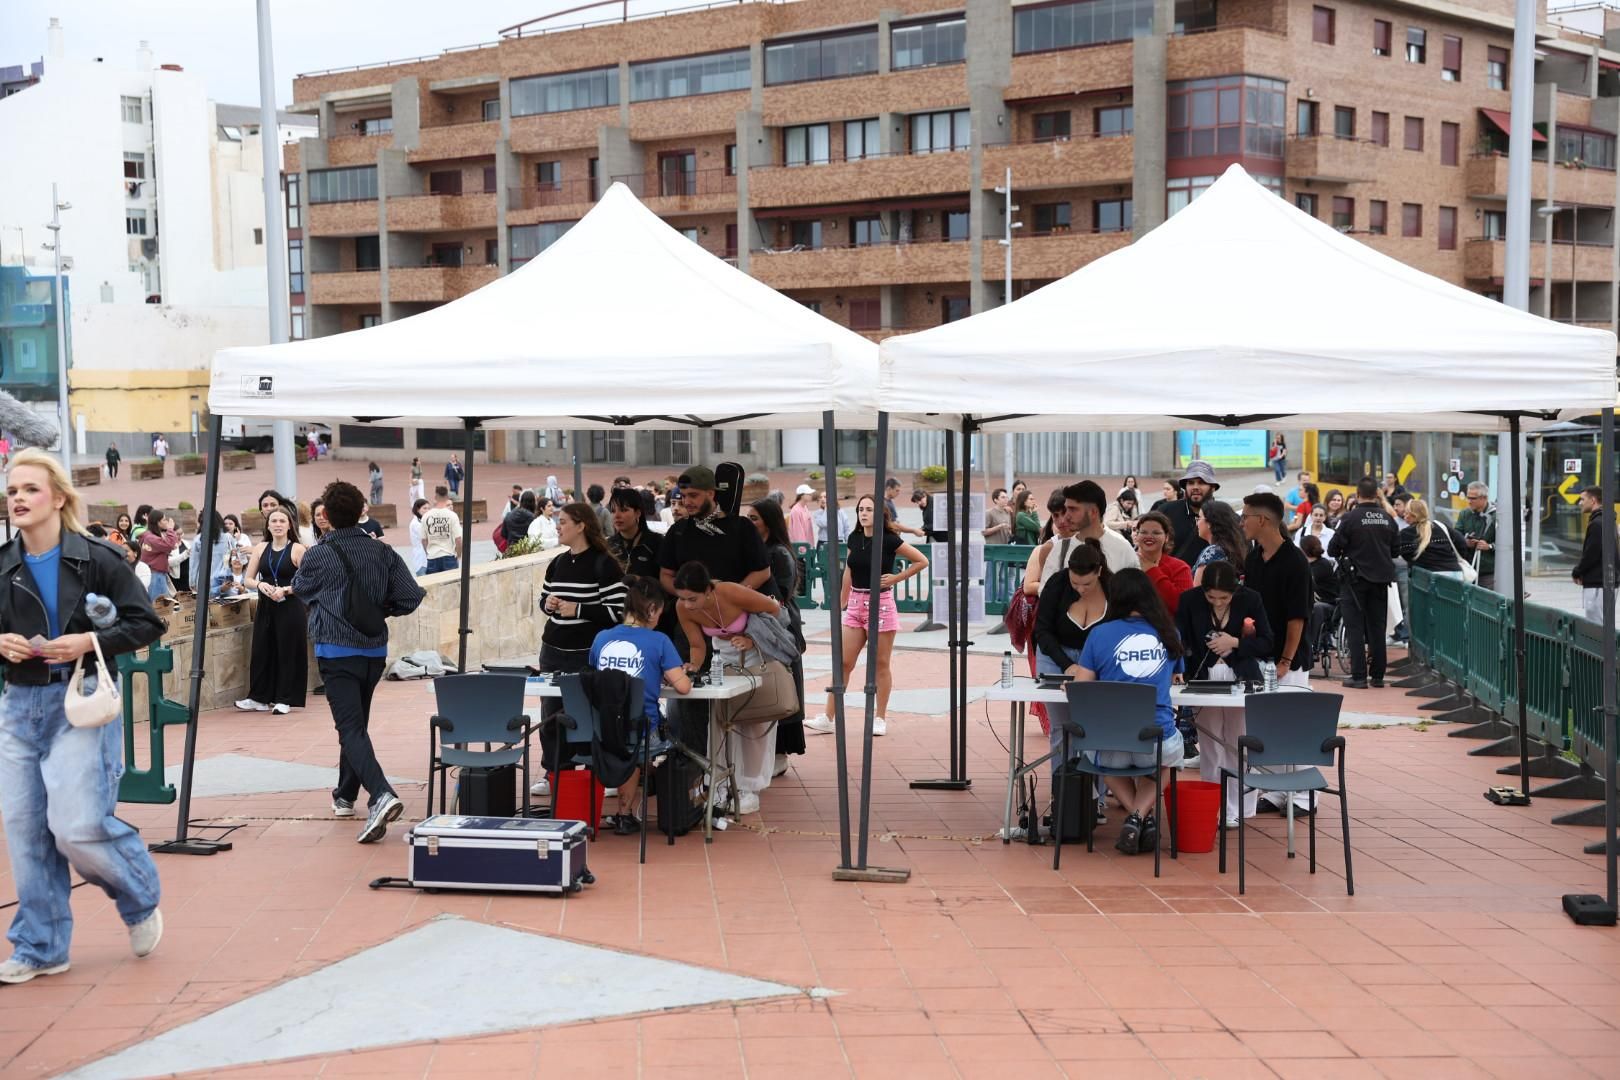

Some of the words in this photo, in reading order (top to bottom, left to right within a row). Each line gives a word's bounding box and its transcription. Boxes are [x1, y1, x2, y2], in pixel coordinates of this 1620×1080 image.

[426, 516, 449, 527] Crazy
[427, 524, 450, 536] Cupid
[1117, 649, 1164, 661] CREW
[600, 656, 641, 668] CREW
